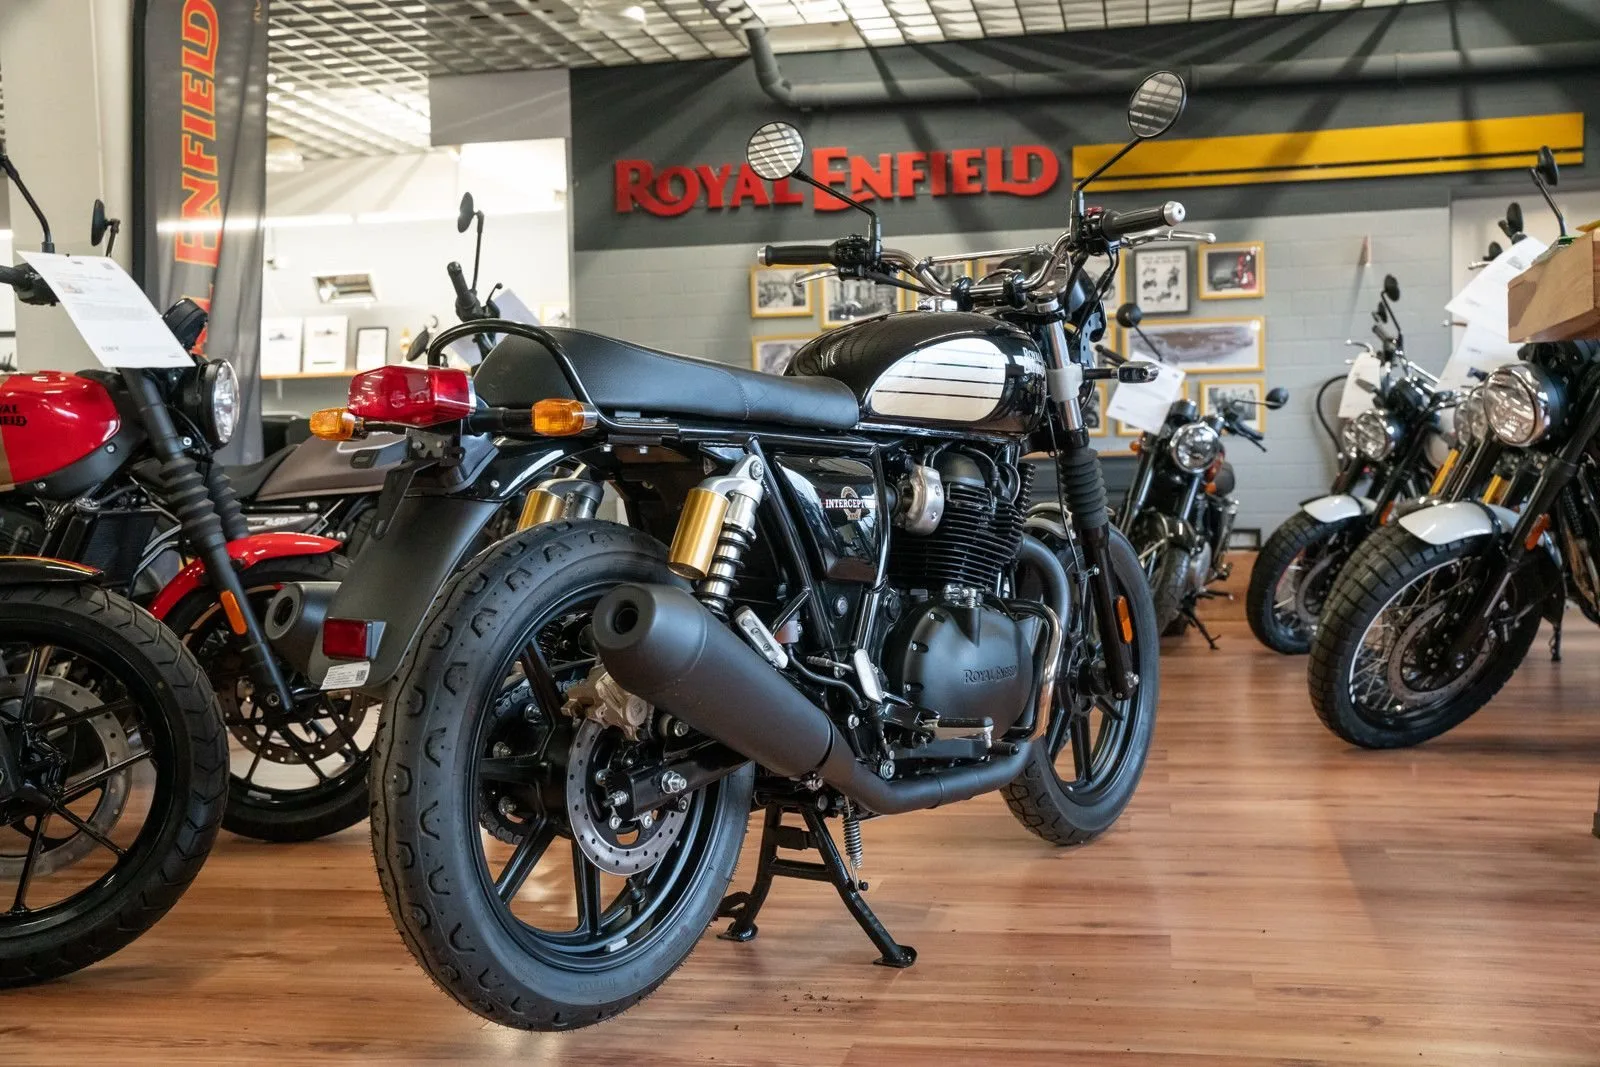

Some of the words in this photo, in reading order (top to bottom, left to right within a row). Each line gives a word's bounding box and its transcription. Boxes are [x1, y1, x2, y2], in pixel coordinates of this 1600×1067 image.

[175, 0, 223, 268] ENFIELD
[615, 159, 804, 217] ROYAL
[812, 145, 1060, 212] ENFIELD
[825, 498, 876, 509] INTERCEPT
[963, 668, 995, 683] ROYAL
